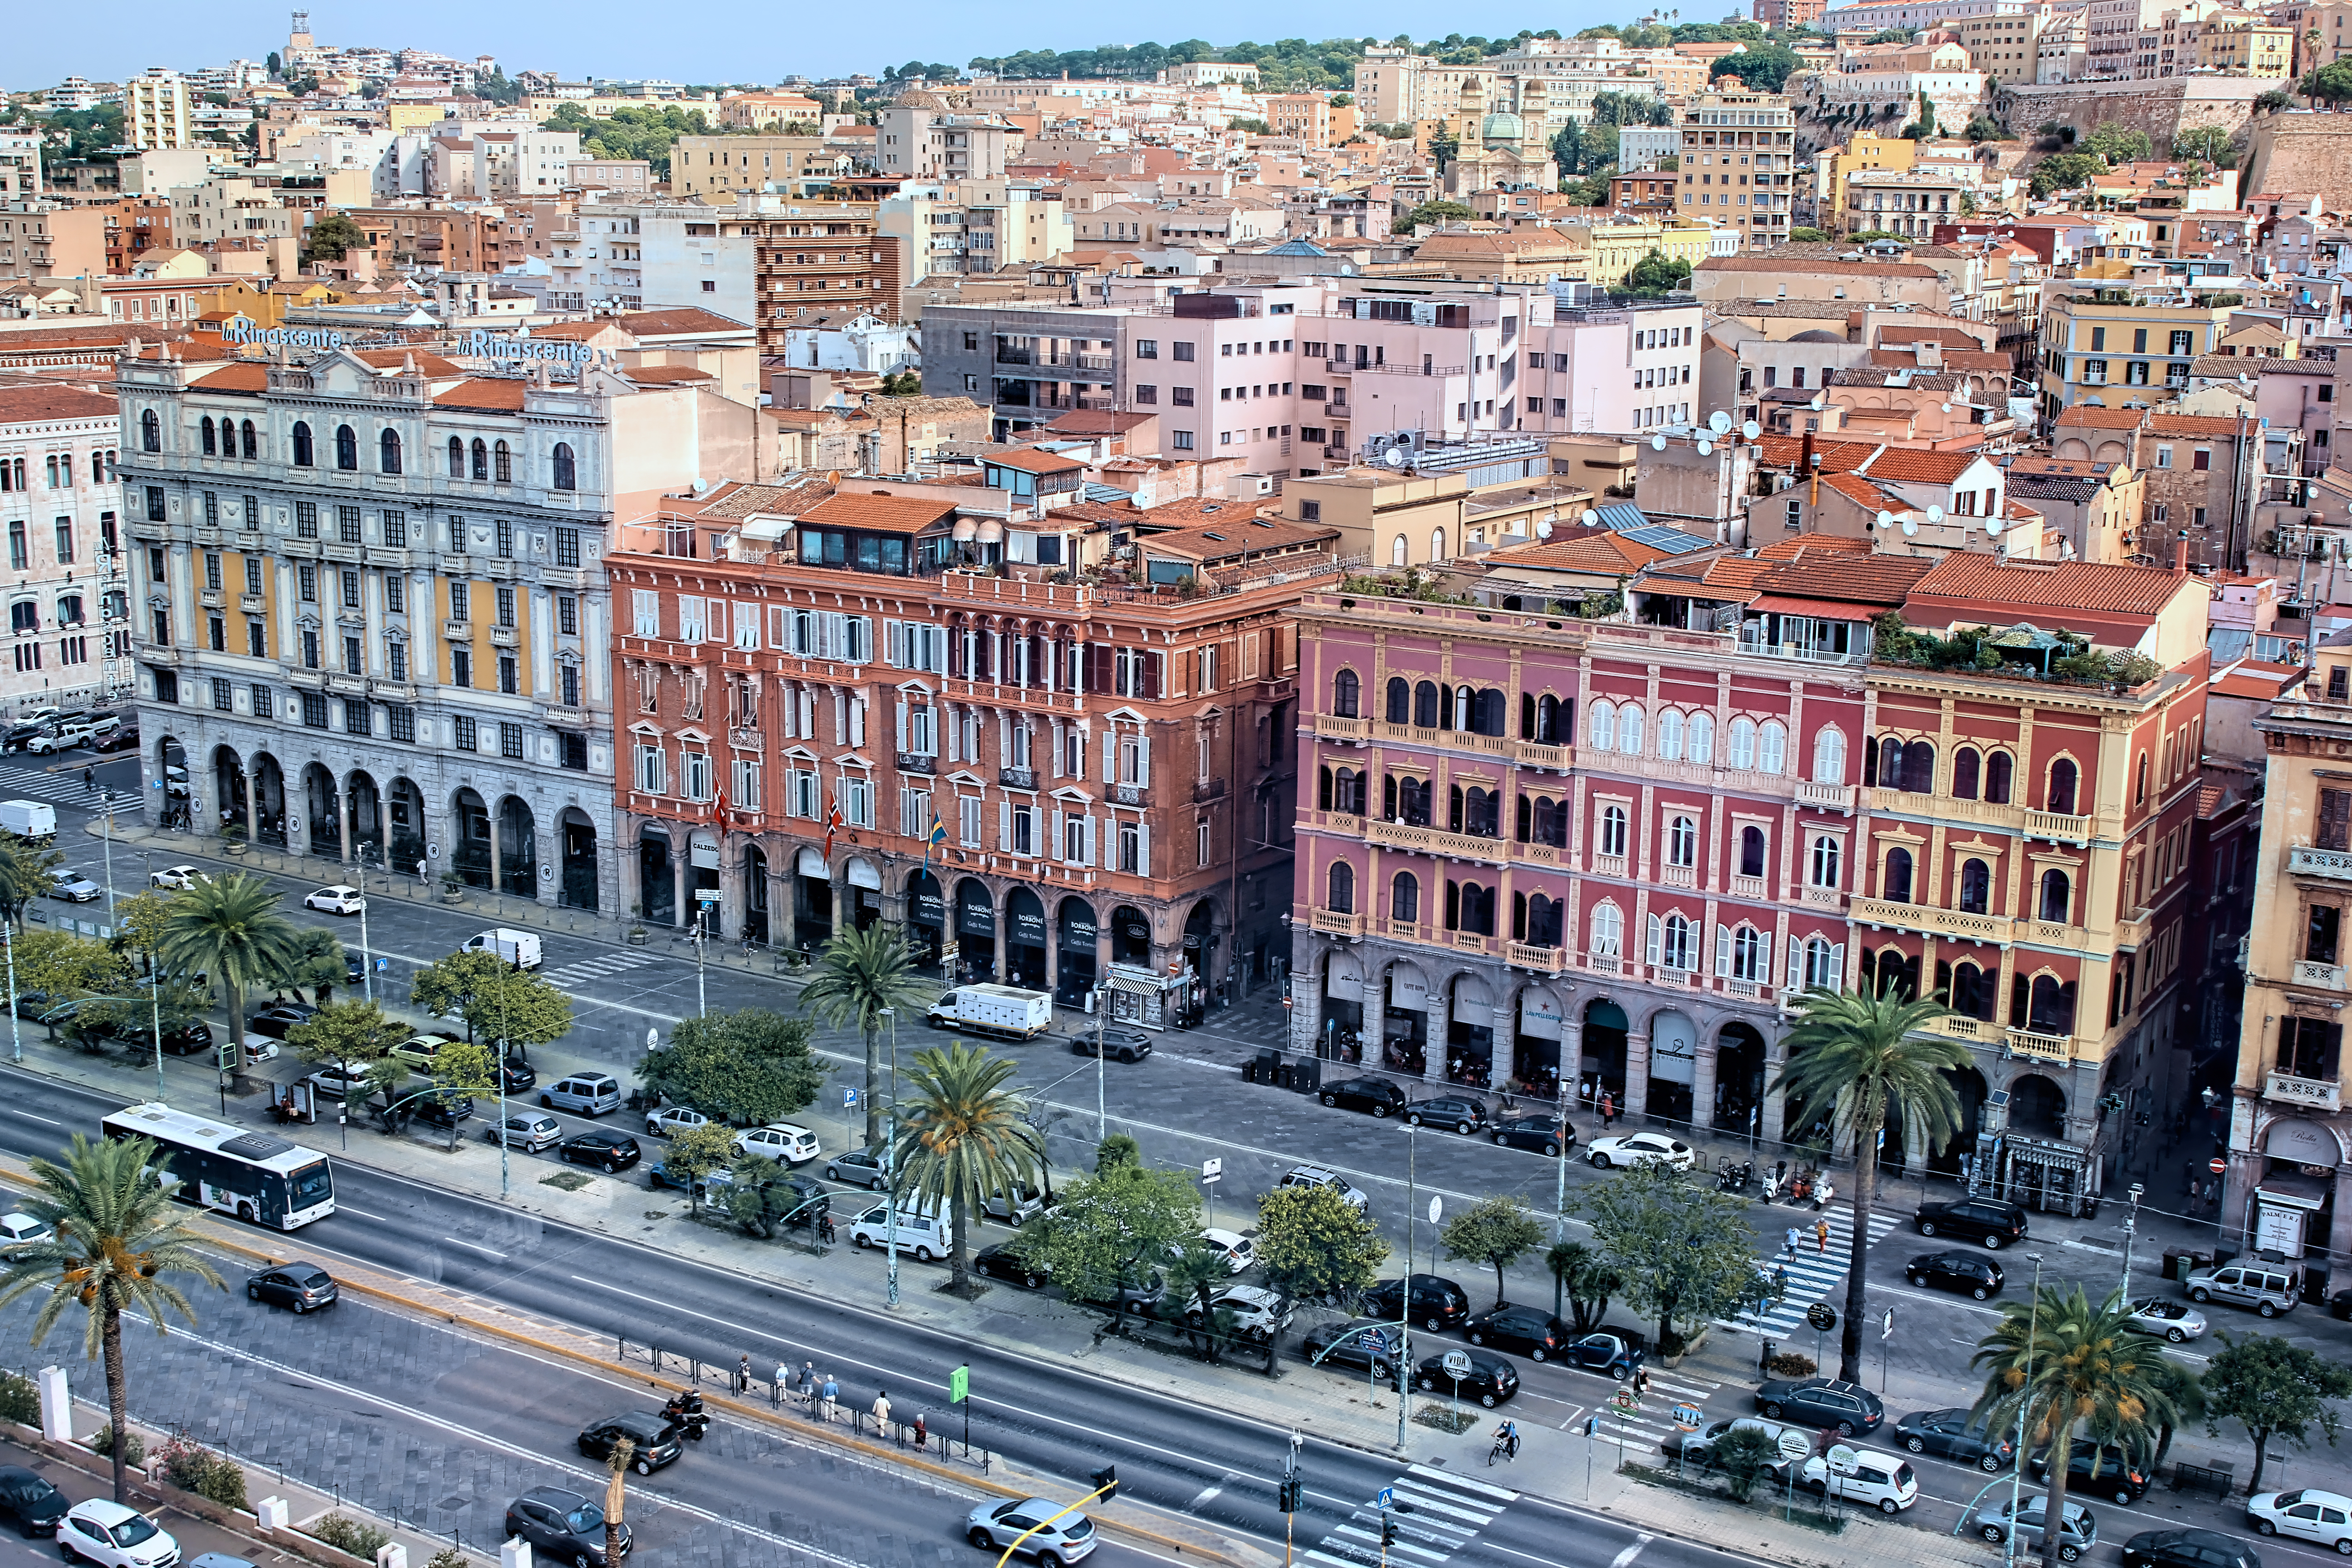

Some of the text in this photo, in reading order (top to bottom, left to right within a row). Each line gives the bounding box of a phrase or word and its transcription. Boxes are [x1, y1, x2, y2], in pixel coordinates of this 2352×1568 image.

[968, 903, 992, 915] BORBONE
[1018, 914, 1044, 924] BORBONE
[1071, 921, 1096, 932] BORBONE
[1468, 999, 1490, 1007] Heineken
[1656, 1054, 1695, 1065] gelateria
[847, 1090, 854, 1102] P
[1751, 1108, 1756, 1120] P
[1879, 1132, 1884, 1143] P
[2290, 1130, 2317, 1142] Rolla
